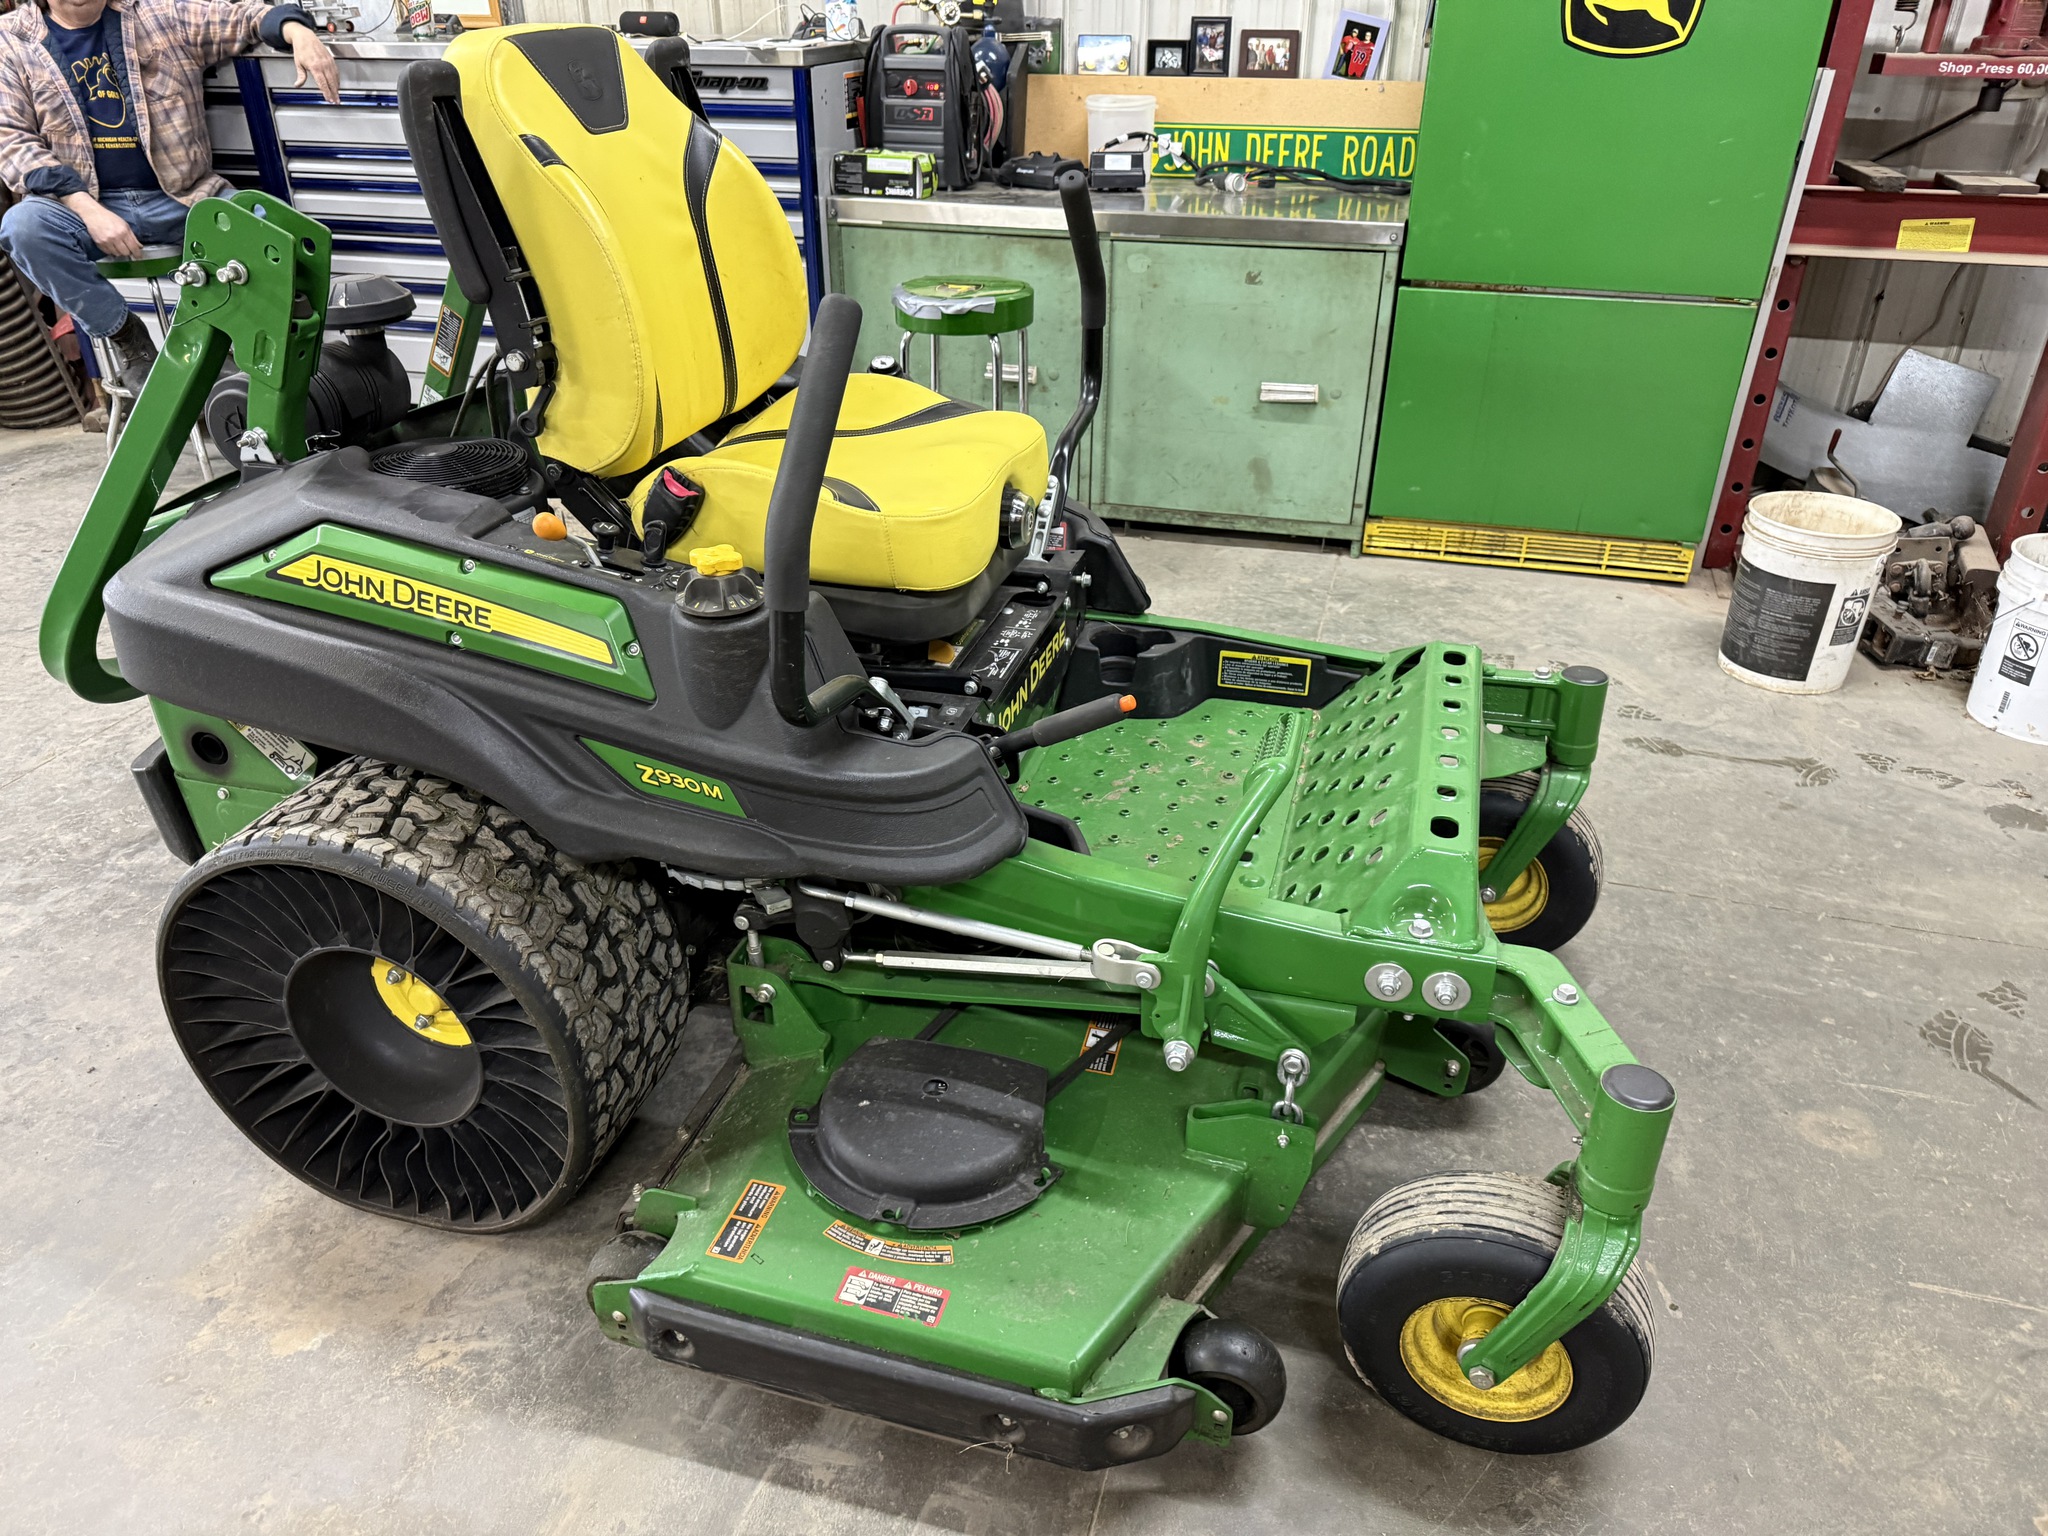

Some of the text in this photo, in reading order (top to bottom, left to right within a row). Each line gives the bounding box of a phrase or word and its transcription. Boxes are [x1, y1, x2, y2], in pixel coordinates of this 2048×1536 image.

[1938, 61, 1973, 76] Shop
[1975, 62, 2014, 74] Press
[1163, 130, 1416, 178] JOHN DEERE ROAD
[306, 559, 492, 630] JOHN DEERE
[2019, 623, 2046, 637] WARNING
[1030, 620, 1067, 694] DEERE
[634, 761, 725, 801] Z930M
[761, 1195, 778, 1219] WARNING
[868, 1272, 896, 1284] DANGER
[913, 1283, 943, 1296] PELIGRO
